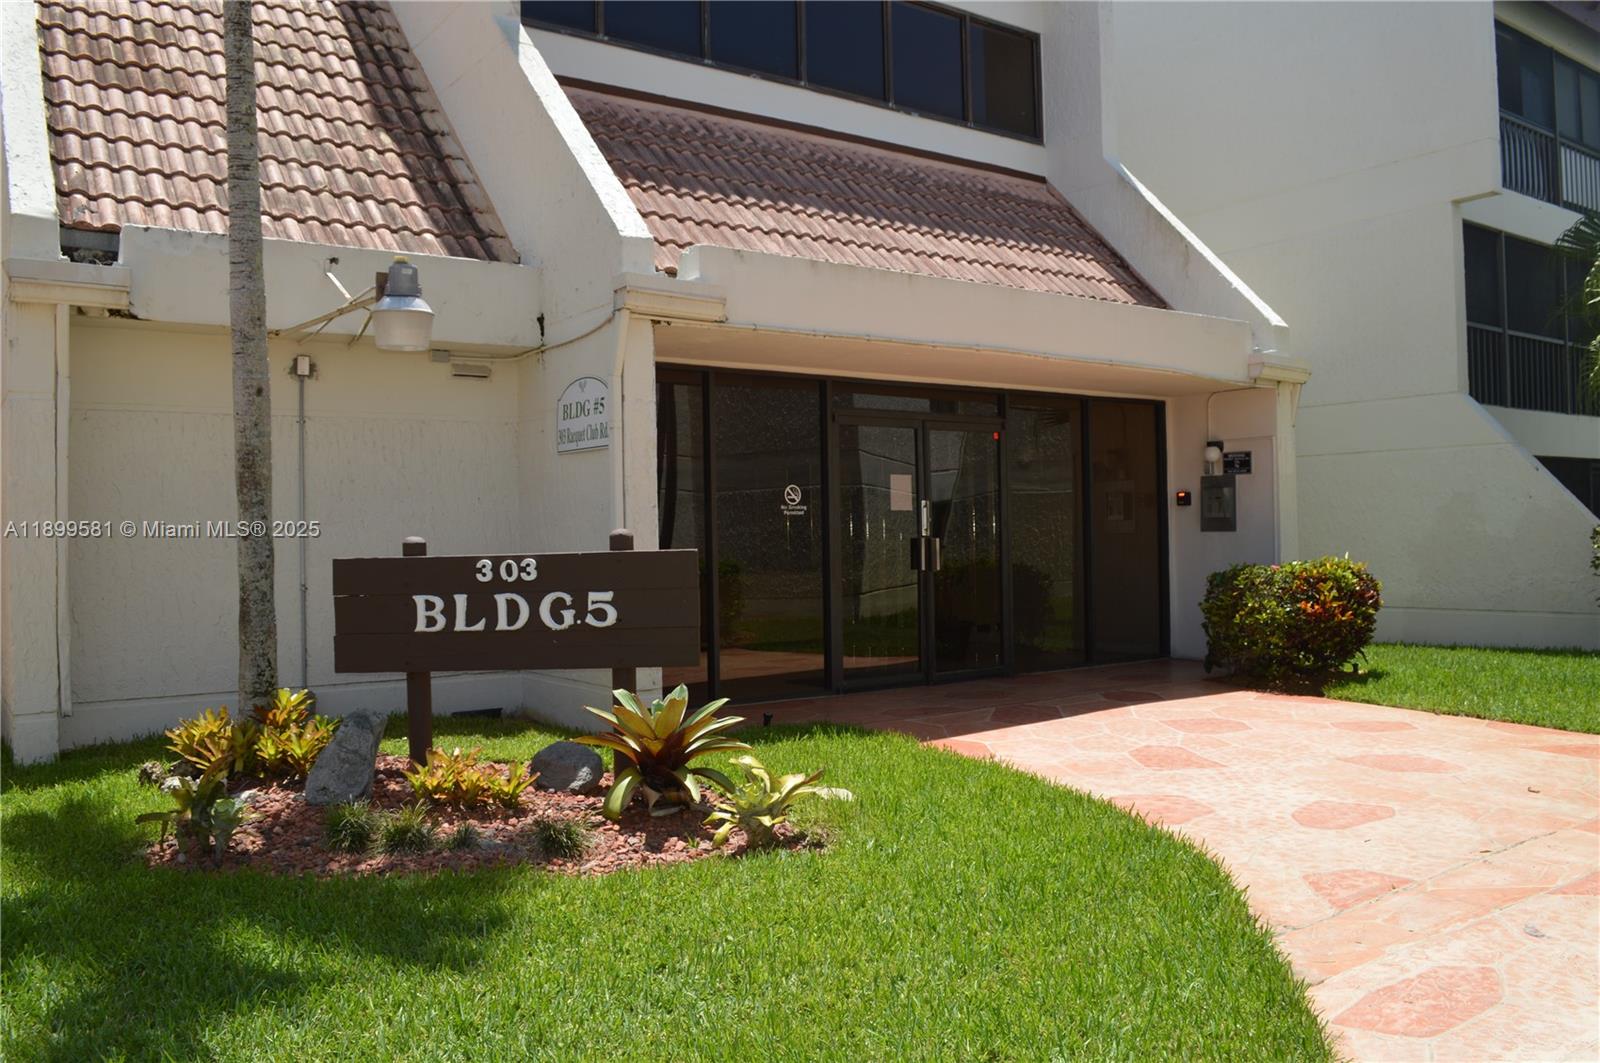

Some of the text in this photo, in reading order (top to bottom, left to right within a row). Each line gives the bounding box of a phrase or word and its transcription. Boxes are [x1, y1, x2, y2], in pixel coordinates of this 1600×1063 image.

[562, 396, 606, 421] BLDG #5
[586, 423, 599, 441] Club
[475, 557, 538, 583] 303
